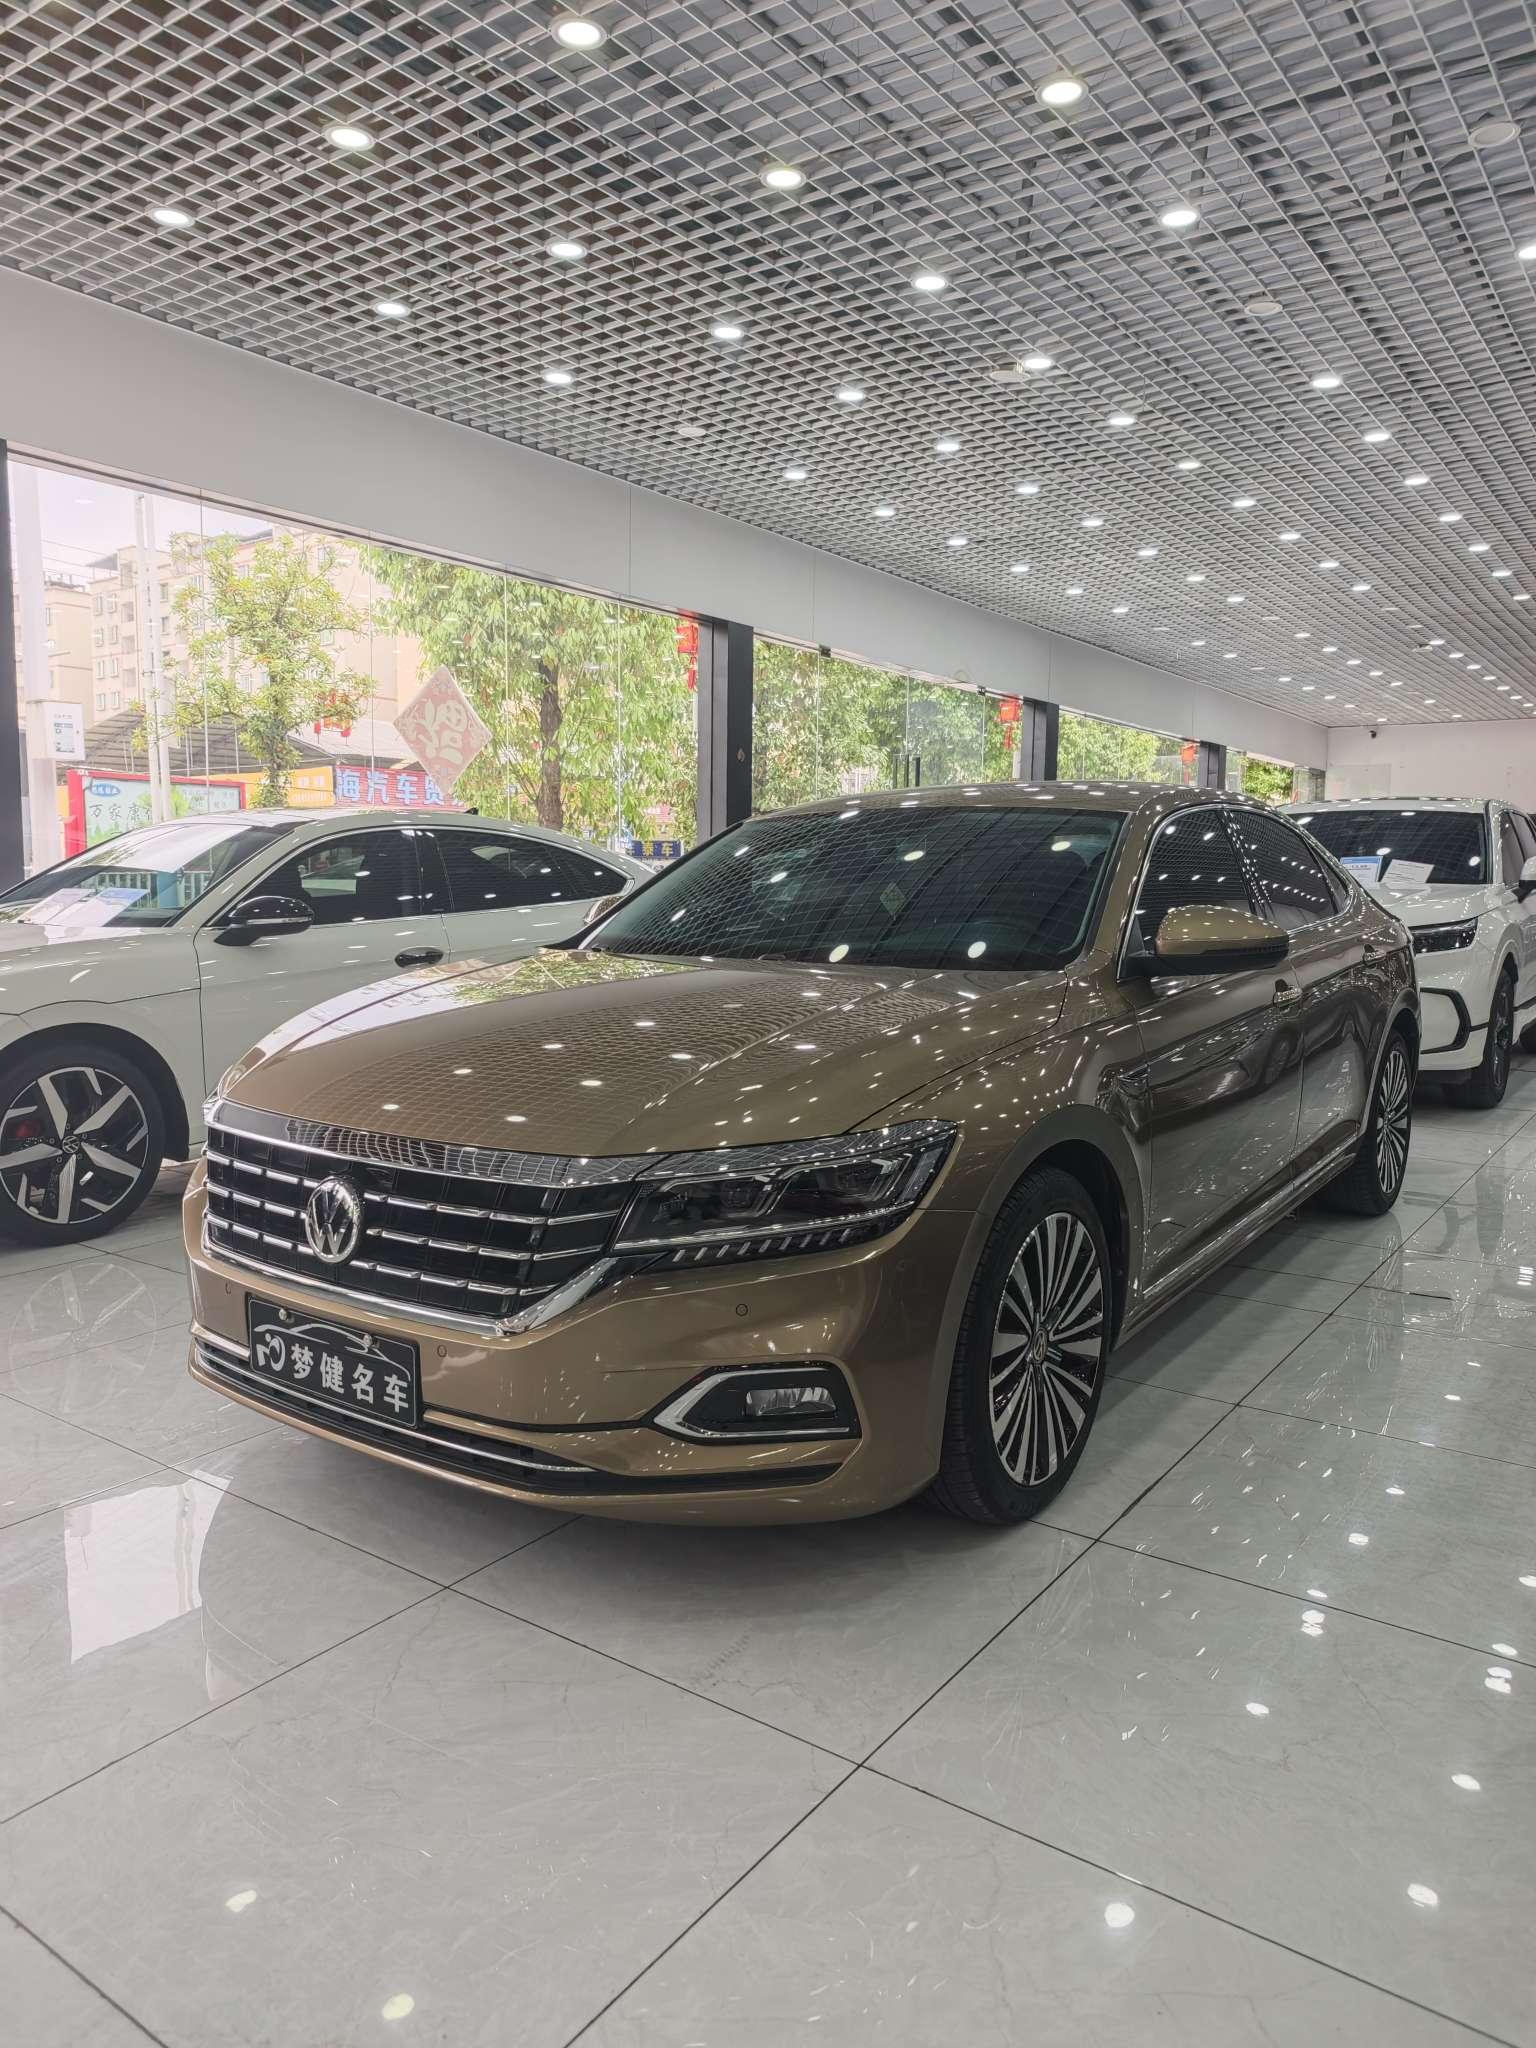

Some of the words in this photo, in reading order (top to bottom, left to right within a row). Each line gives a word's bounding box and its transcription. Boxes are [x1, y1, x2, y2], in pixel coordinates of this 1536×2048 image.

[305, 1178, 360, 1262] VW
[290, 1343, 409, 1413] 梦健名车
